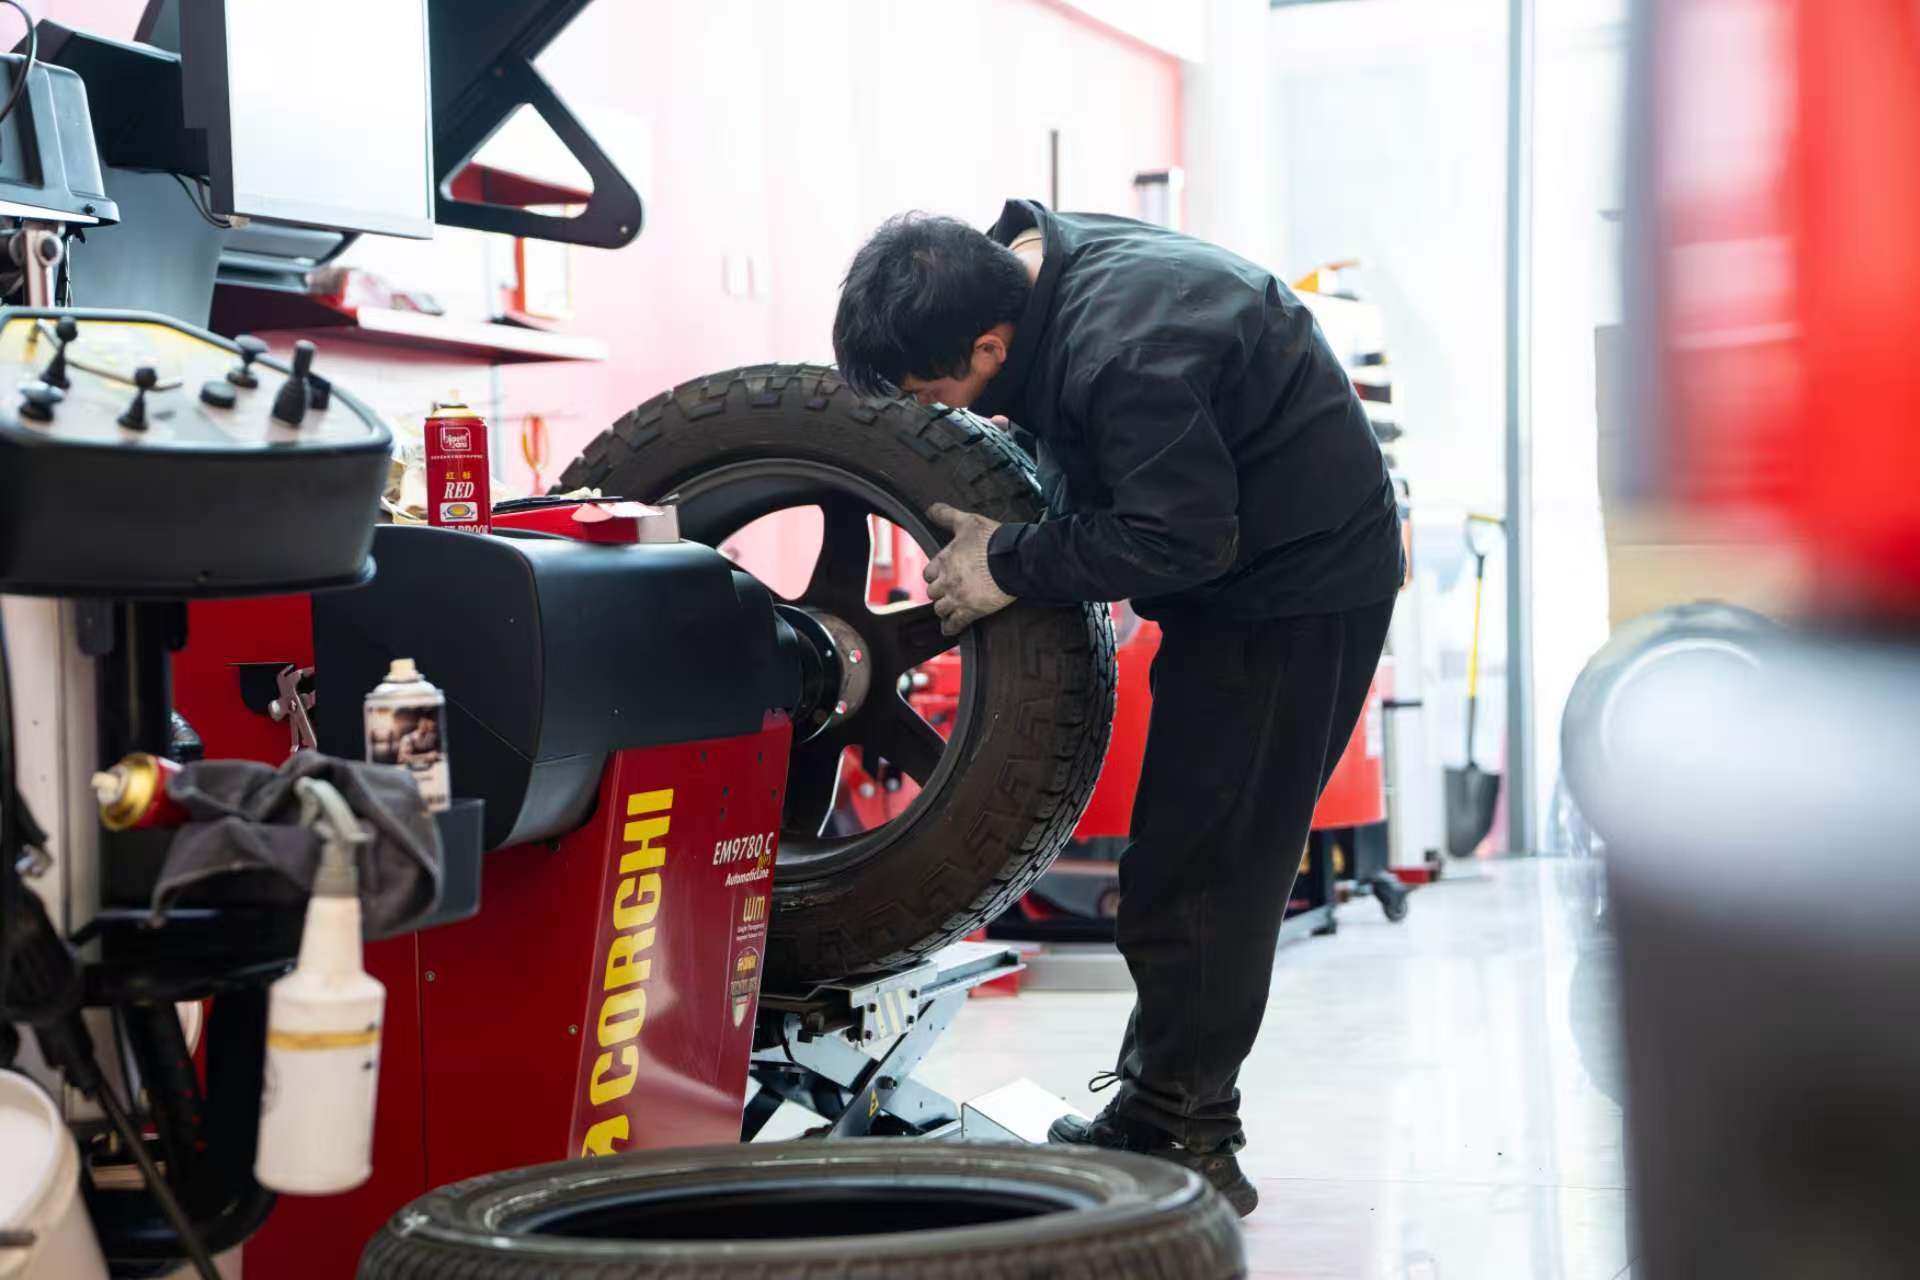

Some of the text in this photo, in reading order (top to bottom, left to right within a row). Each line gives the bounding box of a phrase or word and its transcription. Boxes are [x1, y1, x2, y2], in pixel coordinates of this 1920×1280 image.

[443, 481, 475, 499] RED
[712, 832, 774, 865] EM9780 C
[590, 788, 674, 1106] CORGHI
